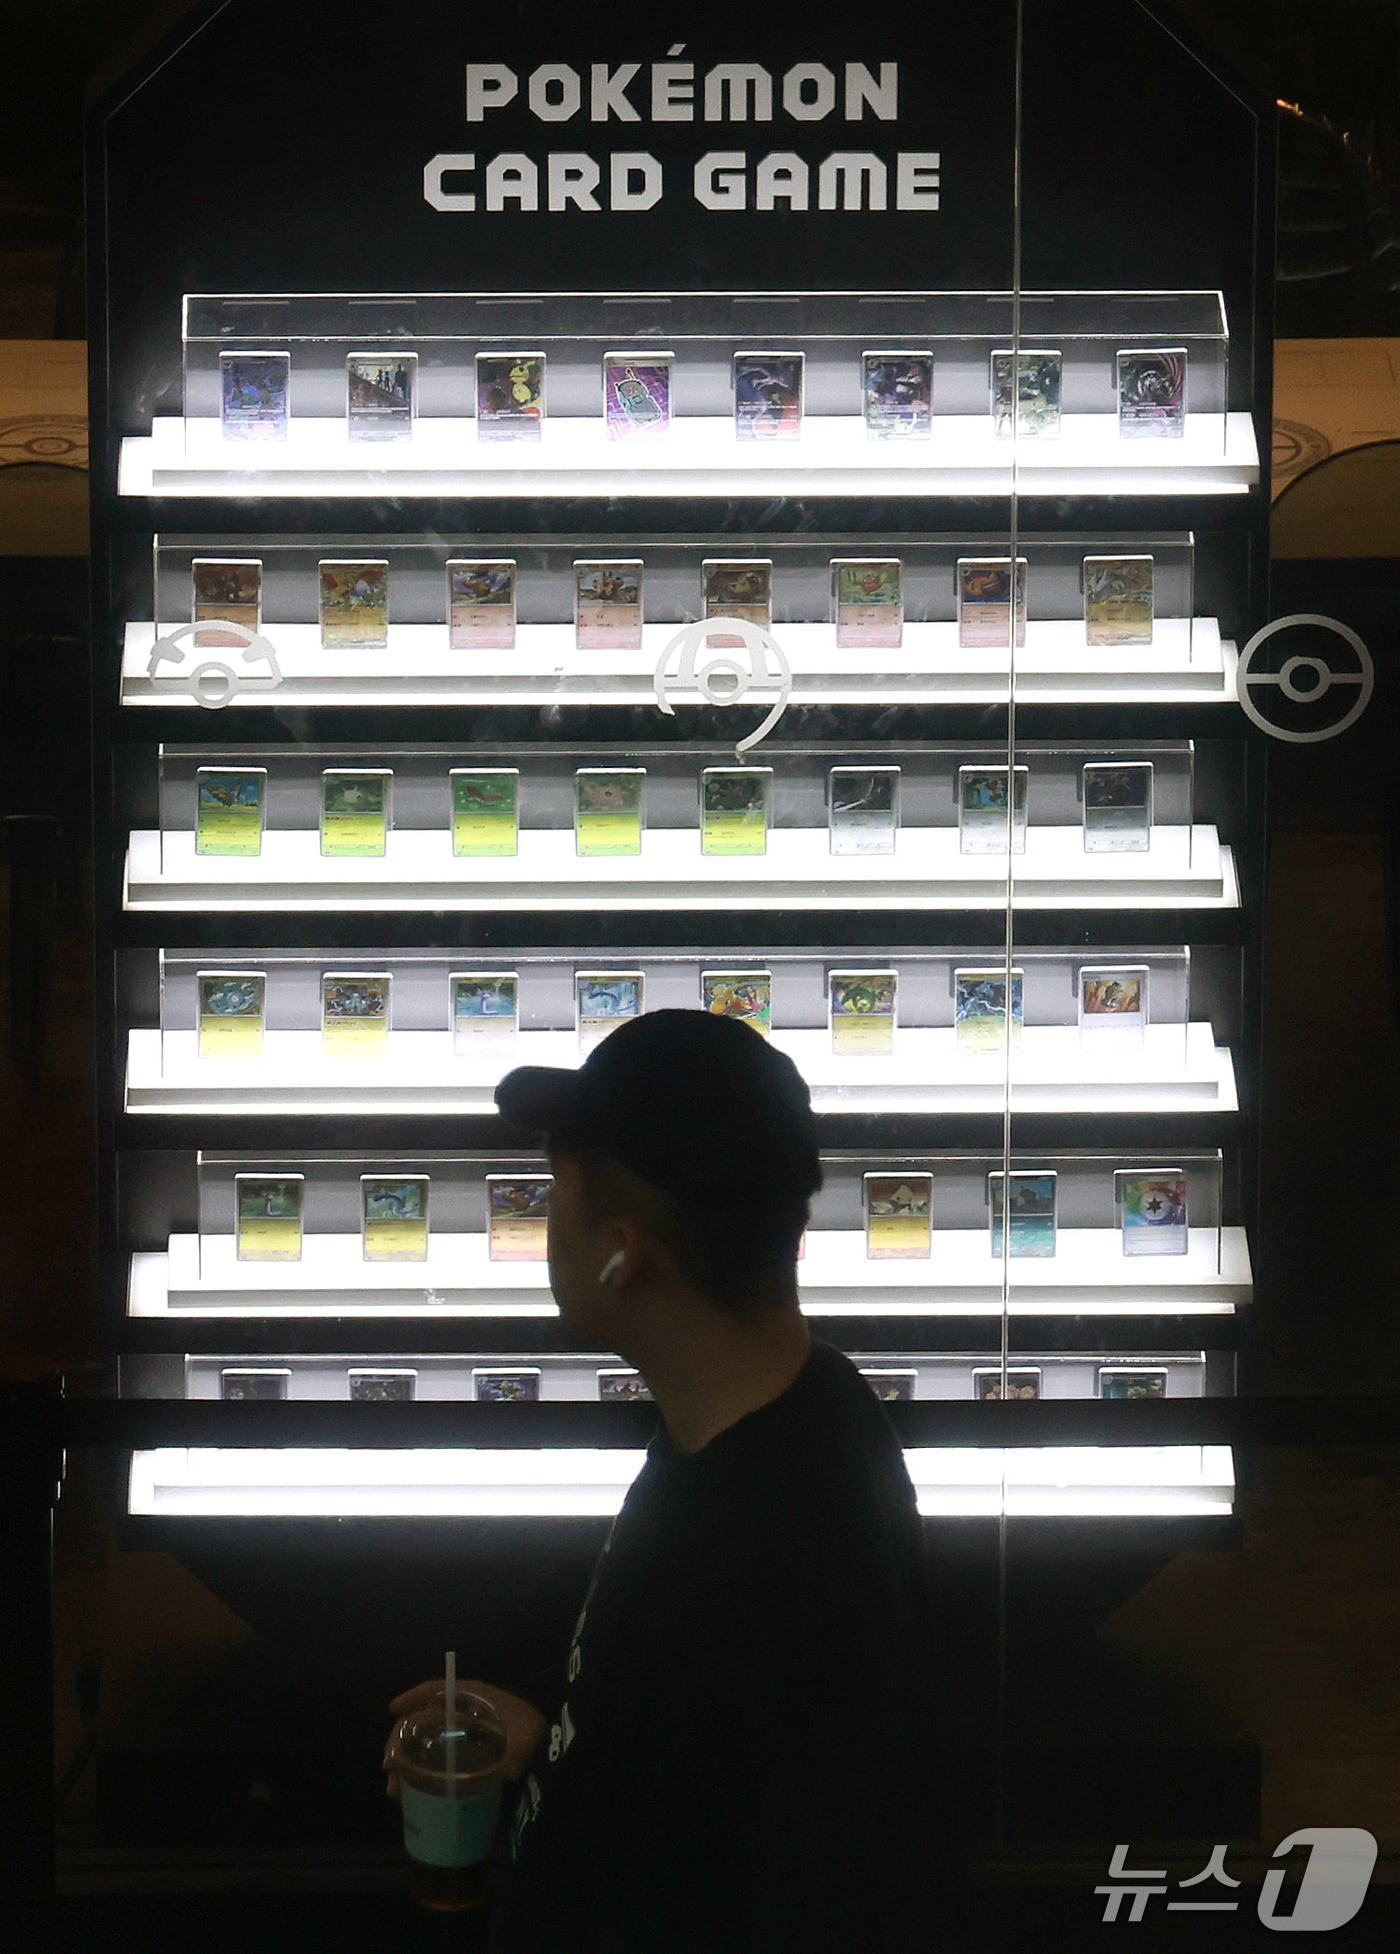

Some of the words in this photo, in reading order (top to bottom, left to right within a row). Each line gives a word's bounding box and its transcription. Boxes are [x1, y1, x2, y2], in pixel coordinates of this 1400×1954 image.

[467, 44, 897, 121] POKÉMON
[424, 152, 662, 211] CARD
[694, 152, 940, 210] GAME
